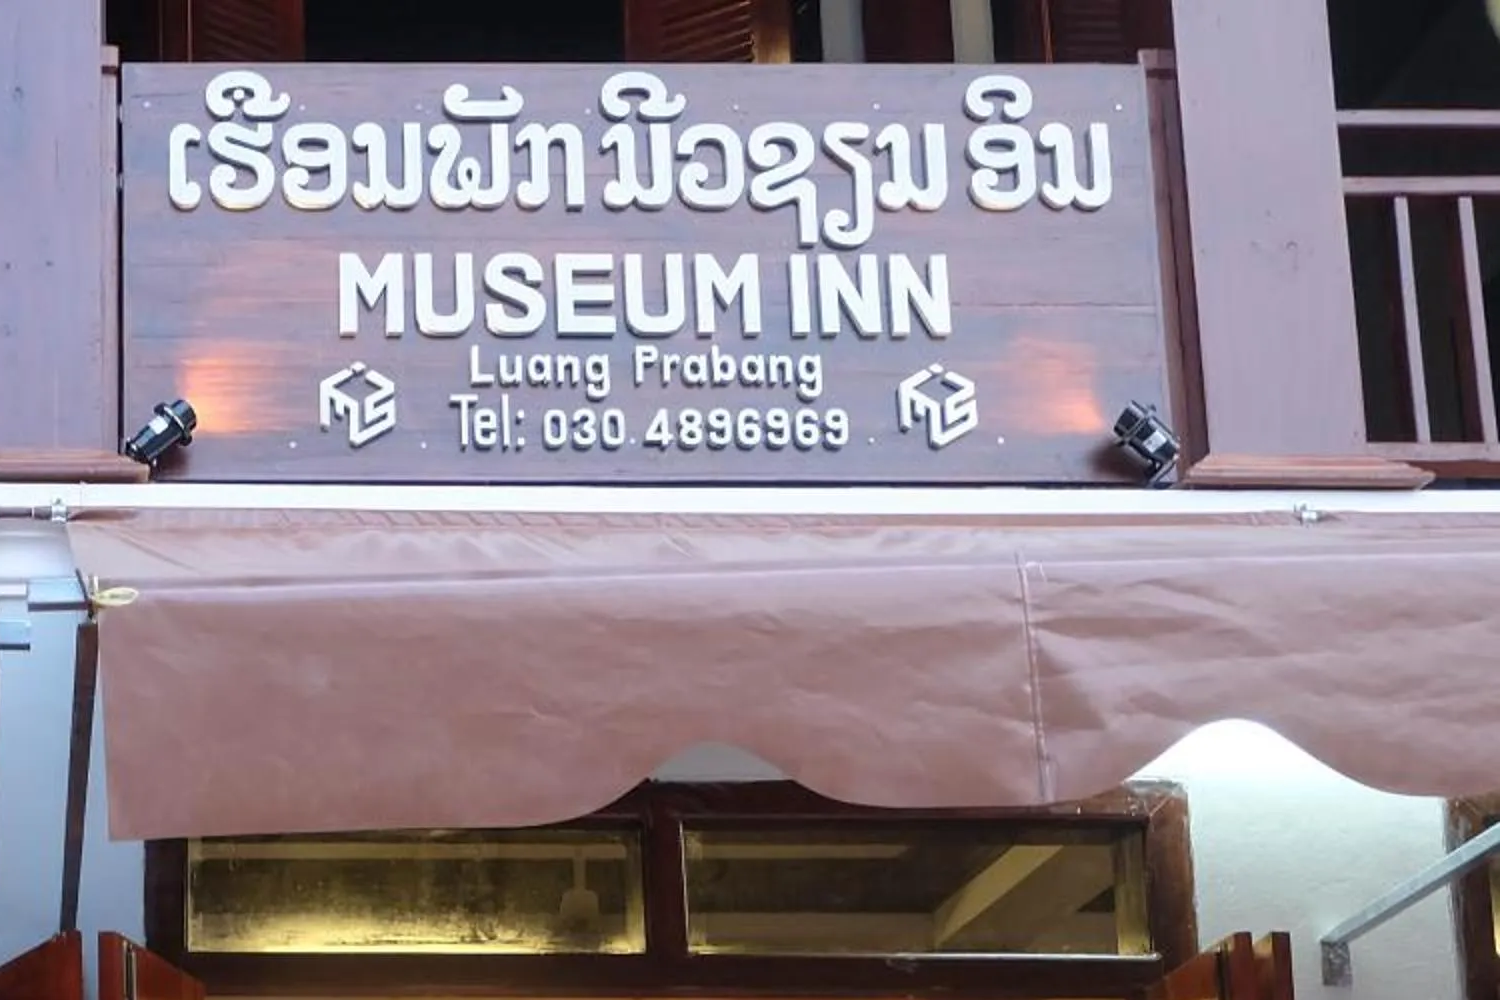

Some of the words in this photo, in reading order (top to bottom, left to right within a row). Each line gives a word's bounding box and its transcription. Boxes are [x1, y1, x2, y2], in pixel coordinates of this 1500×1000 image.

[338, 252, 762, 337] MUSEUM
[789, 253, 952, 338] INN
[469, 345, 612, 398] Luang
[632, 345, 823, 400] Prabang
[450, 393, 526, 449] Tel:
[644, 406, 850, 450] 4896969
